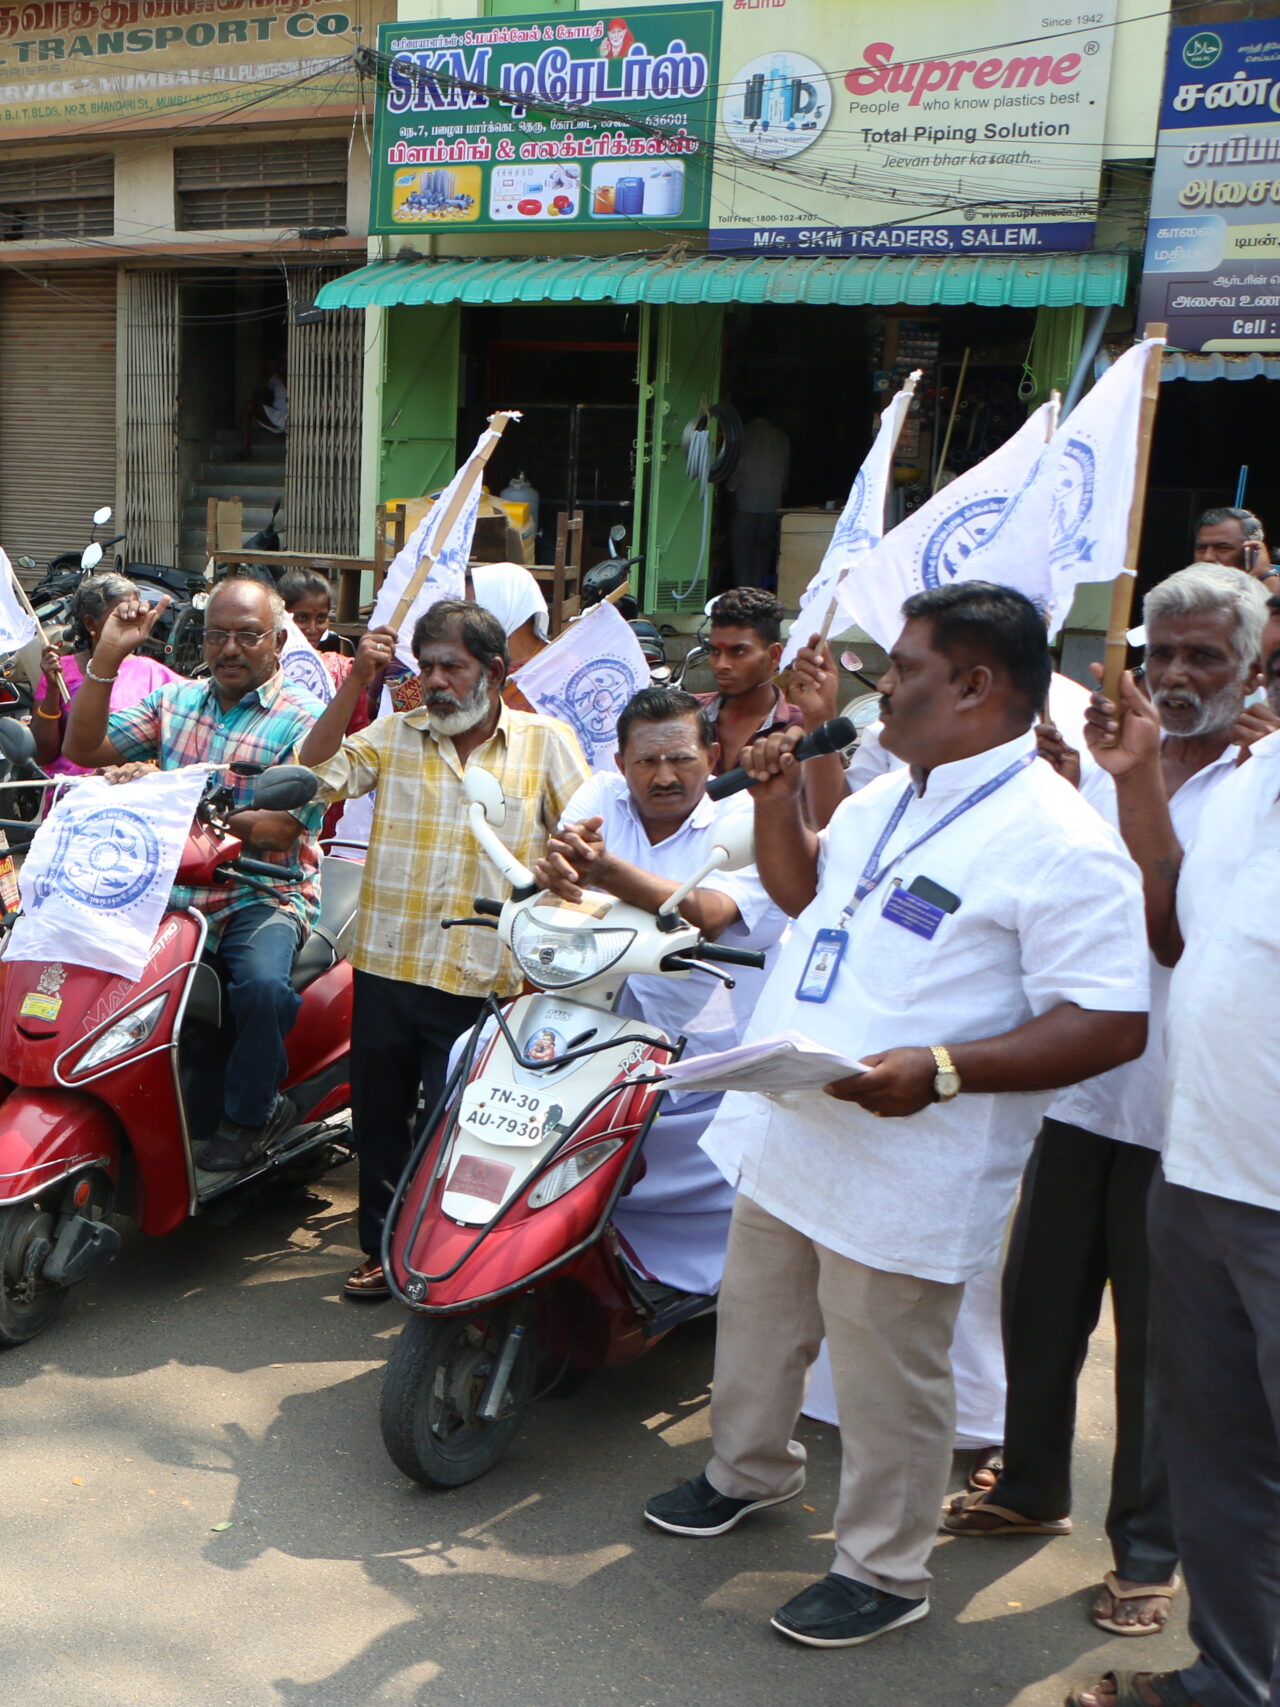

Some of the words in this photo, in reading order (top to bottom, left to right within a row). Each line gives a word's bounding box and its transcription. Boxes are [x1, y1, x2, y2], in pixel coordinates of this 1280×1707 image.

[543, 28, 553, 40] &
[557, 21, 604, 42] கோமதி
[1041, 16, 1072, 28] Since
[1077, 13, 1103, 26] 1942
[12, 16, 278, 63] TRANSPORT
[286, 13, 363, 38] CO.
[1186, 39, 1219, 56] حلال
[98, 69, 200, 94] MUMBAI
[387, 47, 492, 113] SKM
[500, 39, 709, 118] டிரேடர்ஸ்
[844, 42, 1082, 107] Supreme
[849, 99, 900, 115] People
[923, 97, 948, 111] who
[952, 96, 990, 110] know
[994, 93, 1045, 110] plastics
[1049, 92, 1080, 105] best
[861, 127, 907, 144] Total
[914, 125, 977, 145] Piping
[983, 121, 1070, 140] Solution
[388, 136, 491, 164] பிளம்பிங்
[495, 138, 516, 160] &
[882, 154, 930, 169] Jeevan
[933, 152, 967, 166] bhar
[969, 152, 986, 165] ka
[798, 230, 842, 248] SKM
[850, 229, 954, 249] TRADERS,
[961, 228, 1042, 246] SALEM.
[1233, 319, 1266, 334] Cell
[544, 1009, 573, 1022] TVS
[489, 1087, 541, 1112] TN-30
[465, 1110, 540, 1140] AU-7930
